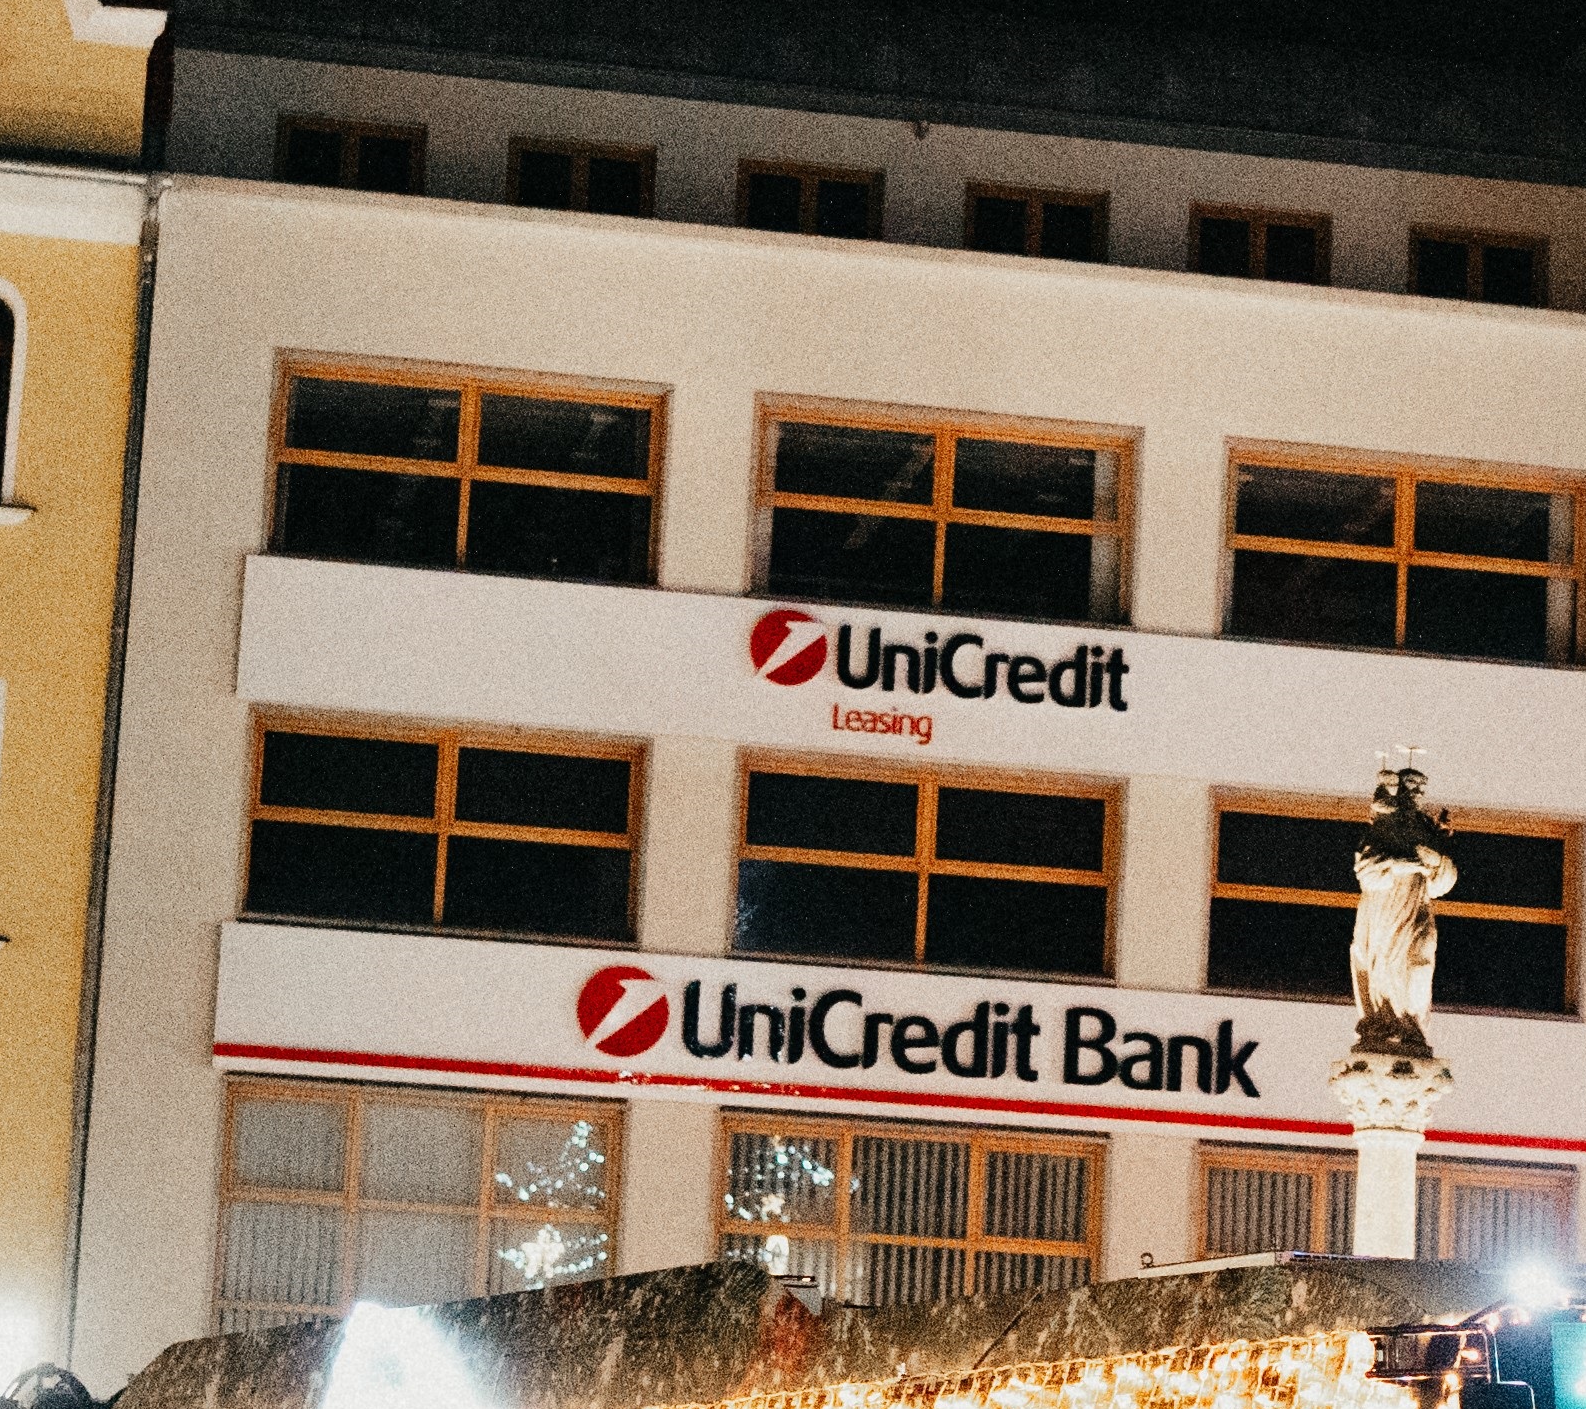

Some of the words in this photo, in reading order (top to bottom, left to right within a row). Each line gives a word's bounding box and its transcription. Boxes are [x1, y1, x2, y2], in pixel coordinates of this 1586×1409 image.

[835, 622, 1130, 712] UniCredit
[831, 703, 933, 744] Leasing
[681, 979, 1038, 1083] UniCredit
[1064, 1006, 1261, 1098] Bank
